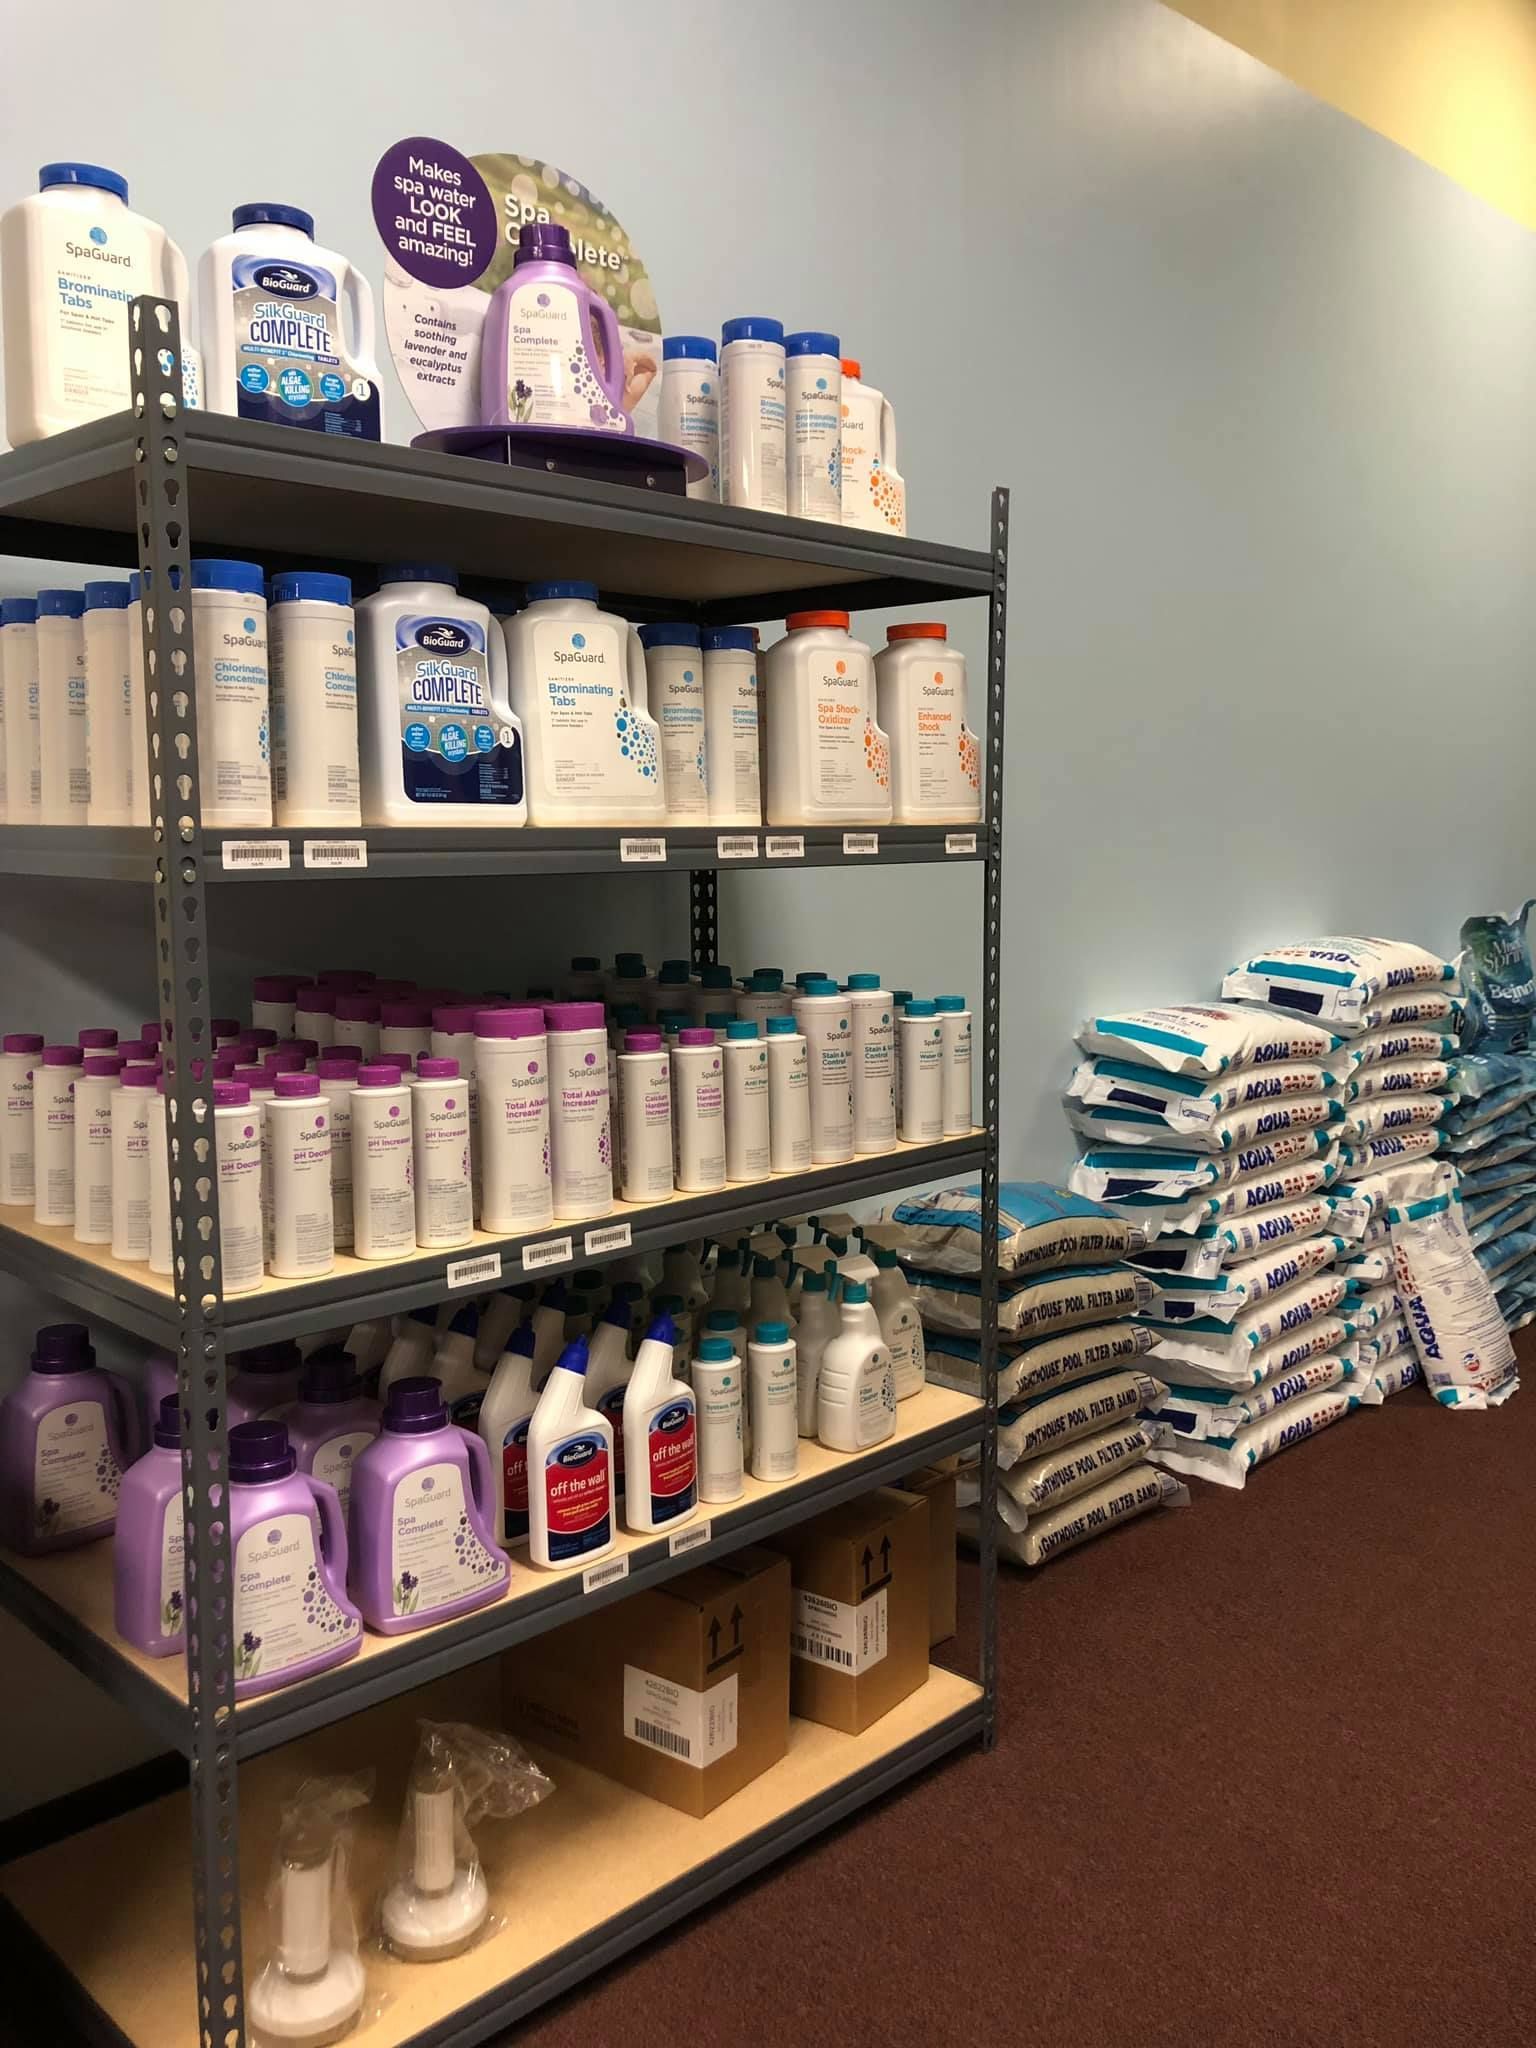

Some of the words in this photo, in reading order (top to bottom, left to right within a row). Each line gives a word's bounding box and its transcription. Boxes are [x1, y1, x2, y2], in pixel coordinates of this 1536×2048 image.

[409, 156, 462, 185] Makes
[394, 174, 424, 195] spa
[429, 182, 476, 208] water
[410, 196, 462, 225] LOOK
[504, 194, 550, 226] Spa
[395, 214, 427, 234] and
[432, 223, 476, 247] FEEL
[65, 241, 131, 267] SpaGuard
[398, 235, 474, 266] amazing!
[505, 222, 621, 270] Clete
[58, 277, 135, 302] Brominatin
[262, 277, 310, 293] BioGuard
[59, 292, 92, 309] Tabs
[255, 304, 325, 328] SilkGuard
[414, 314, 457, 331] Contains
[520, 308, 567, 322] SpaGuard
[250, 320, 331, 352] COMPLETE
[414, 329, 457, 346] soothing
[513, 325, 531, 336] Spa
[404, 340, 446, 360] lavender
[448, 348, 468, 361] and
[513, 336, 559, 347] Complete
[410, 356, 462, 374] eucalyptus
[281, 376, 302, 385] ALGAE
[417, 371, 456, 387] extracts
[285, 384, 310, 394] KILLING
[840, 420, 864, 430] Guard
[842, 446, 866, 455] hock-
[424, 636, 464, 648] BioGuard
[554, 651, 604, 664] SpaGuard
[417, 662, 477, 681] SilkGuard
[549, 683, 613, 696] Brominating
[823, 676, 858, 687] SpaGuard
[413, 678, 482, 704] COMPLETE
[923, 686, 954, 696] SpaGuard
[550, 696, 576, 706] Tabs
[818, 704, 833, 713] Spa
[818, 715, 851, 724] Oxidizer
[918, 712, 951, 720] Enhanced
[919, 722, 940, 730] Shock
[442, 733, 459, 741] ALGAE
[445, 740, 466, 750] KILLING
[504, 732, 510, 743] 1
[1254, 1042, 1290, 1063] AQUA
[562, 1091, 583, 1099] Total
[1245, 1078, 1282, 1100] AQUA
[505, 1102, 526, 1110] Total
[563, 1099, 599, 1107] Increaser
[506, 1109, 542, 1119] Increaser
[1257, 1111, 1290, 1135] AQUA
[294, 1152, 306, 1160] pH
[1370, 1137, 1405, 1158] AQUA
[221, 1164, 234, 1172] pH
[1239, 1146, 1275, 1172] AQUA
[1246, 1182, 1284, 1208] AQUA
[1258, 1215, 1294, 1242] AQUA
[1079, 1235, 1103, 1250] FILTER
[1267, 1260, 1299, 1290] AQUA
[1065, 1296, 1084, 1313] POOL
[1087, 1291, 1113, 1308] FILTER
[1115, 1287, 1134, 1301] SAND
[1280, 1303, 1312, 1334] AQUA
[1408, 1295, 1444, 1360] AQUA
[1062, 1353, 1083, 1373] POOL
[1085, 1345, 1110, 1362] FILTER
[1112, 1338, 1133, 1354] SAND
[1281, 1343, 1311, 1371] AQUA
[1272, 1374, 1307, 1404] AQUA
[1067, 1407, 1089, 1428] POOL
[1089, 1396, 1115, 1418] FILTER
[1117, 1389, 1137, 1409] SAND
[1279, 1417, 1312, 1448] AQUA
[563, 1448, 593, 1463] BioGuard
[653, 1446, 666, 1462] off
[668, 1442, 681, 1456] the
[1076, 1454, 1098, 1476] POOL
[1097, 1442, 1125, 1466] FILTER
[1126, 1431, 1146, 1451] SAN
[507, 1461, 524, 1477] off
[551, 1481, 568, 1496] off
[570, 1478, 586, 1492] the
[588, 1469, 605, 1487] wall
[404, 1488, 451, 1509] SpaGuard
[1087, 1506, 1108, 1528] POOL
[1108, 1493, 1135, 1517] FILTER
[1137, 1483, 1158, 1504] SAND
[398, 1515, 416, 1527] Spa
[398, 1518, 444, 1536] Complete
[248, 1539, 300, 1563] SpaGuard
[240, 1572, 260, 1583] Spa
[240, 1574, 291, 1593] Complete
